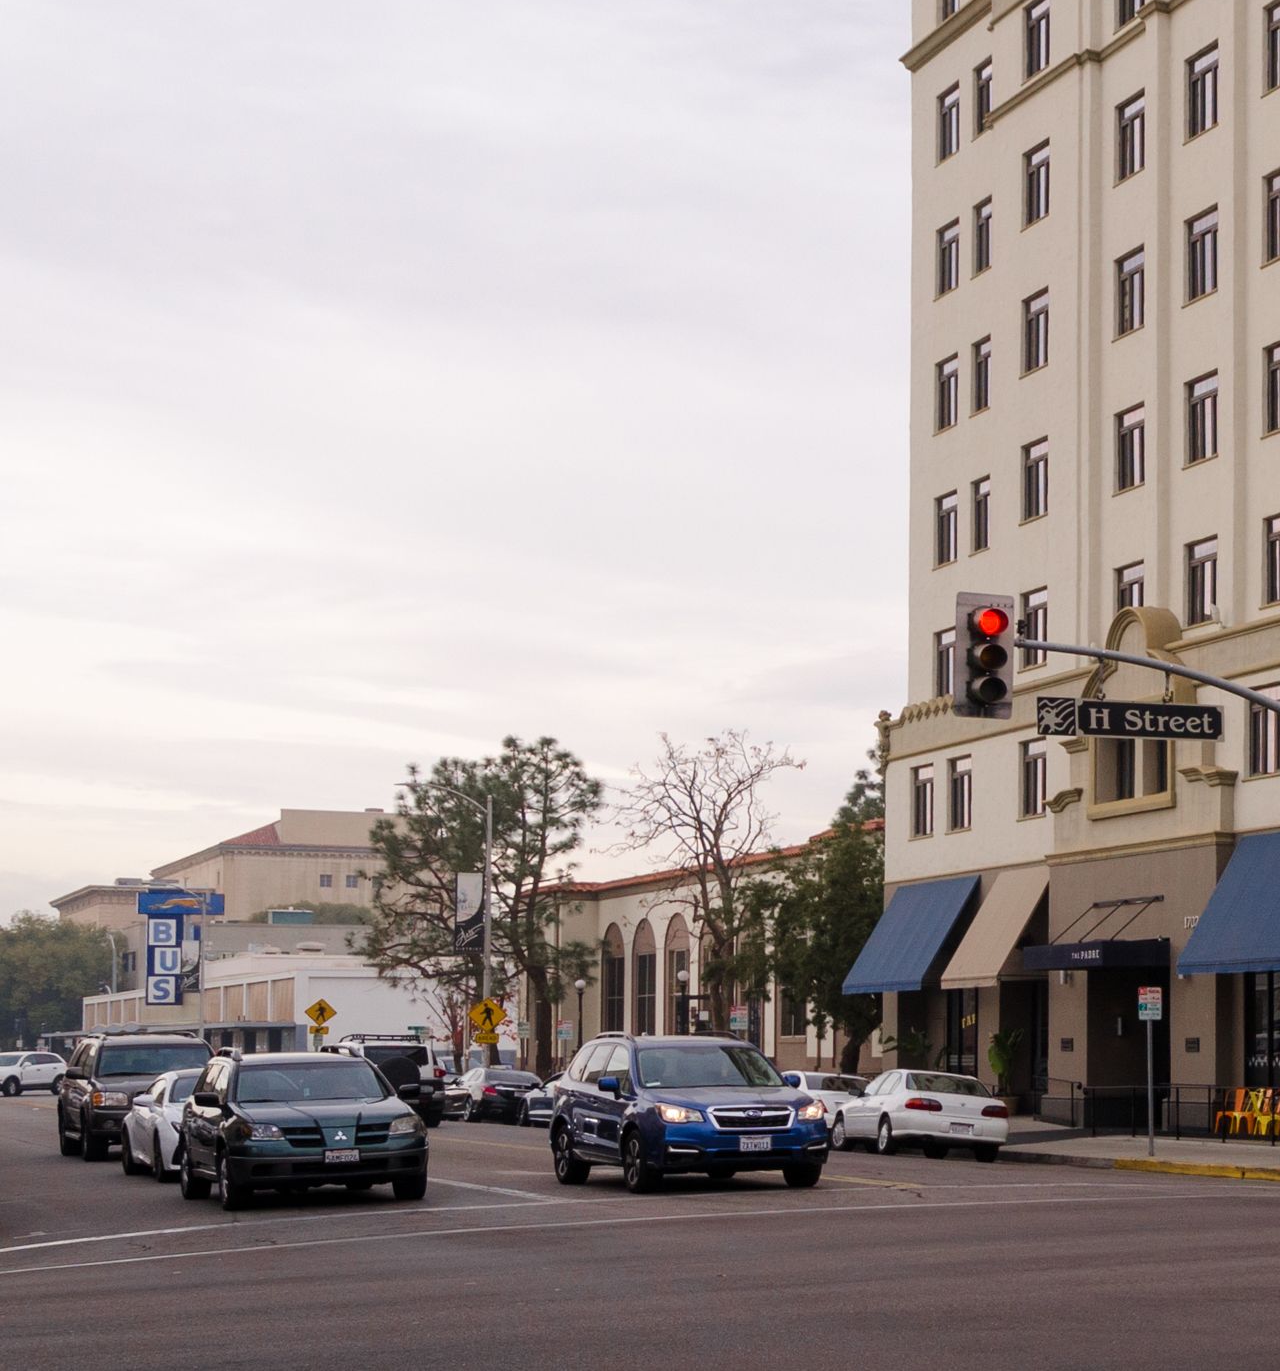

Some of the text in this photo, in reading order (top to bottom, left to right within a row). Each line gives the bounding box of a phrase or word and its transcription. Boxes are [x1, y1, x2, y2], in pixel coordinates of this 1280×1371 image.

[1088, 708, 1214, 734] H Street
[152, 921, 178, 1001] BUS
[1080, 949, 1100, 960] PADRE
